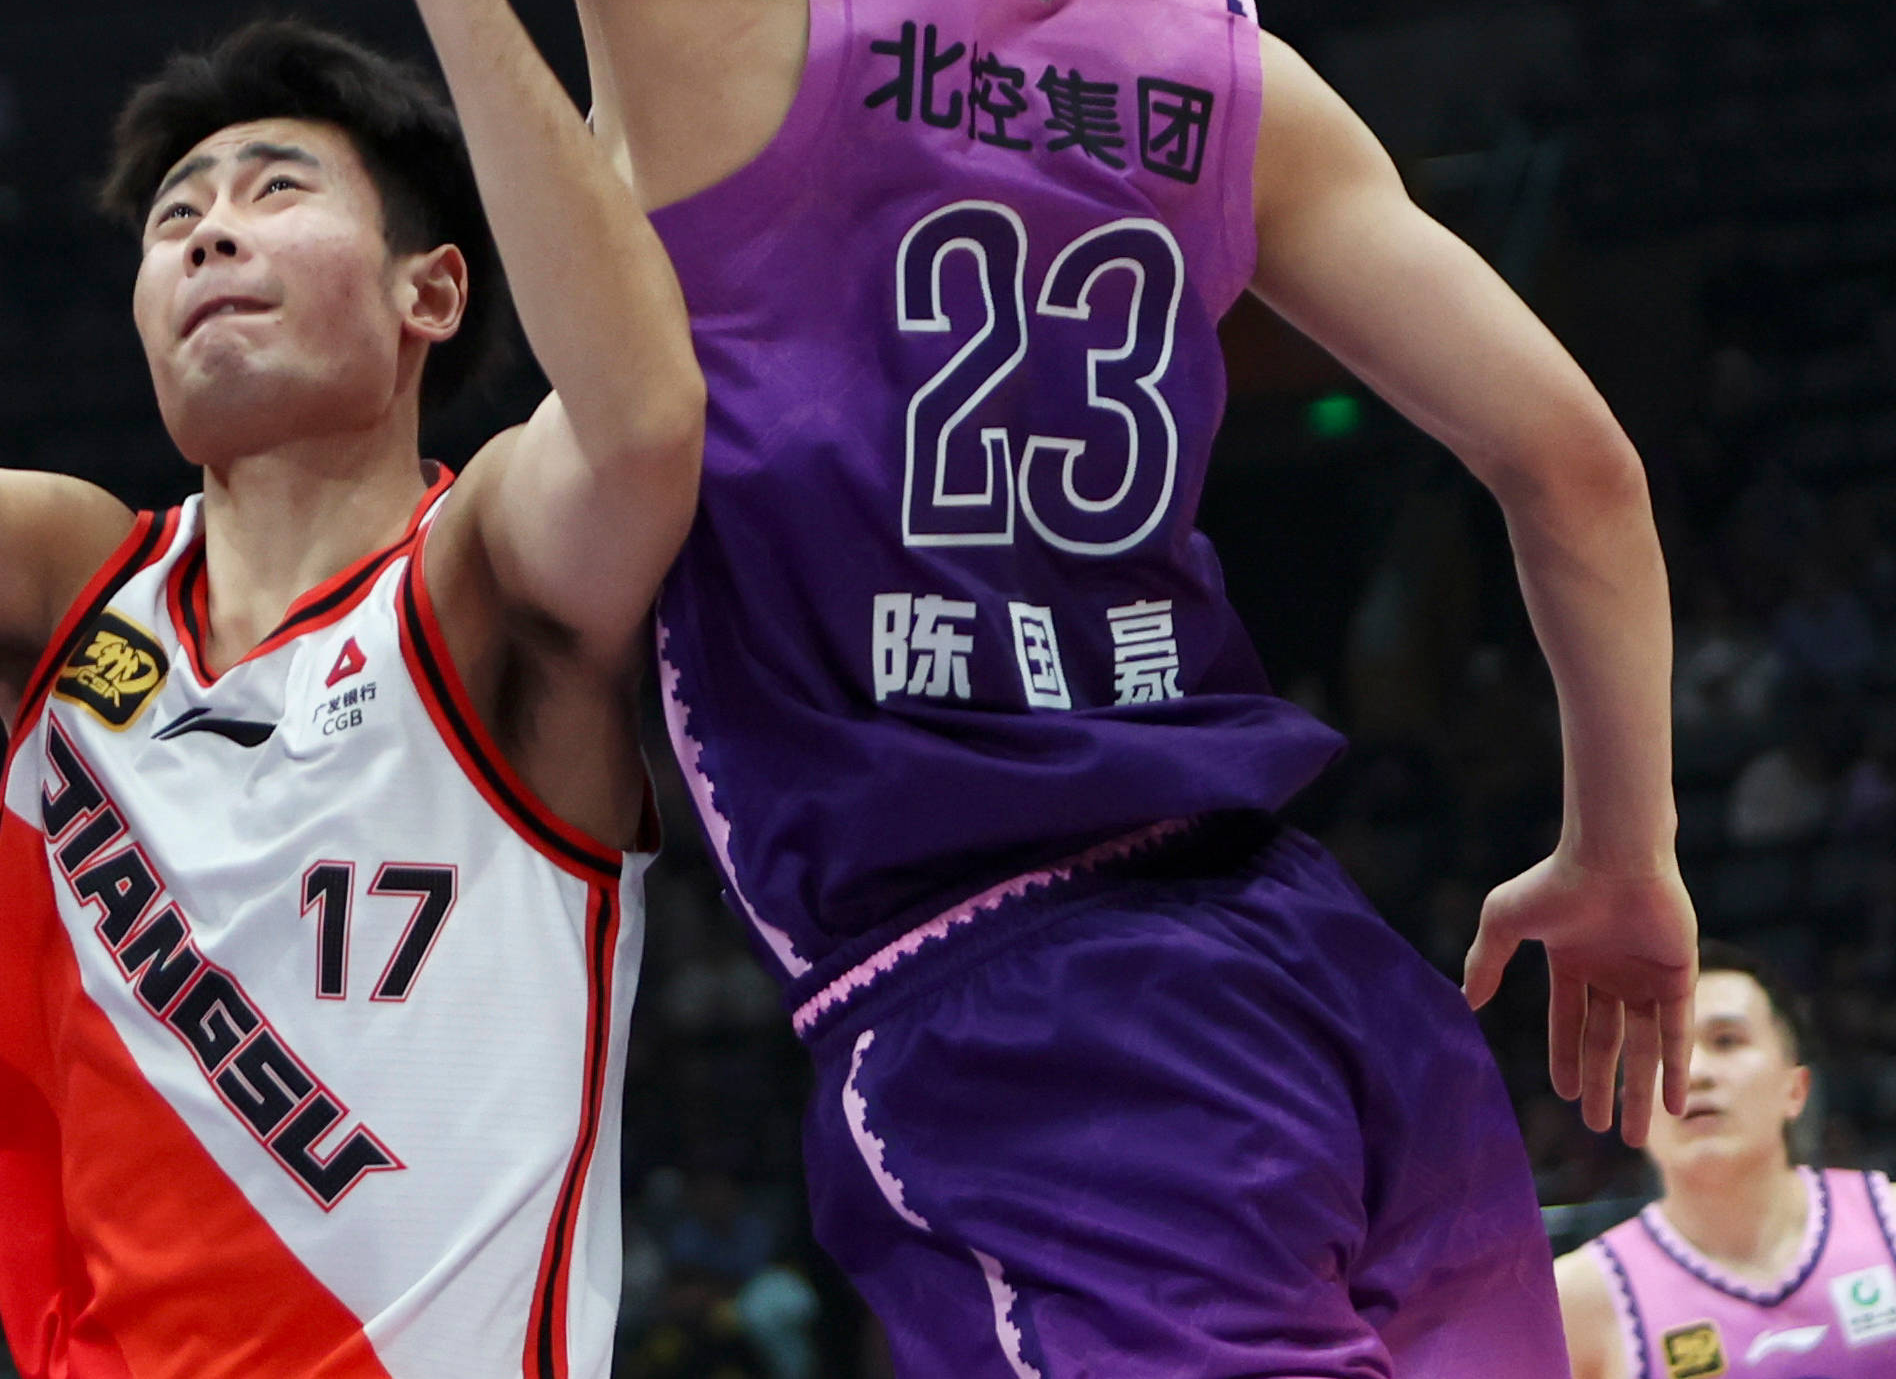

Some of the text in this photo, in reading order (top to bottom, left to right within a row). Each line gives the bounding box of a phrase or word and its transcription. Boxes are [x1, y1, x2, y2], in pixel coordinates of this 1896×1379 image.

[863, 20, 1214, 185] 北控集团
[897, 199, 1185, 555] 23
[322, 708, 363, 736] CGB
[872, 592, 1184, 711] 陈国豪
[41, 709, 407, 1213] JIANGSU
[300, 859, 458, 1003] 17
